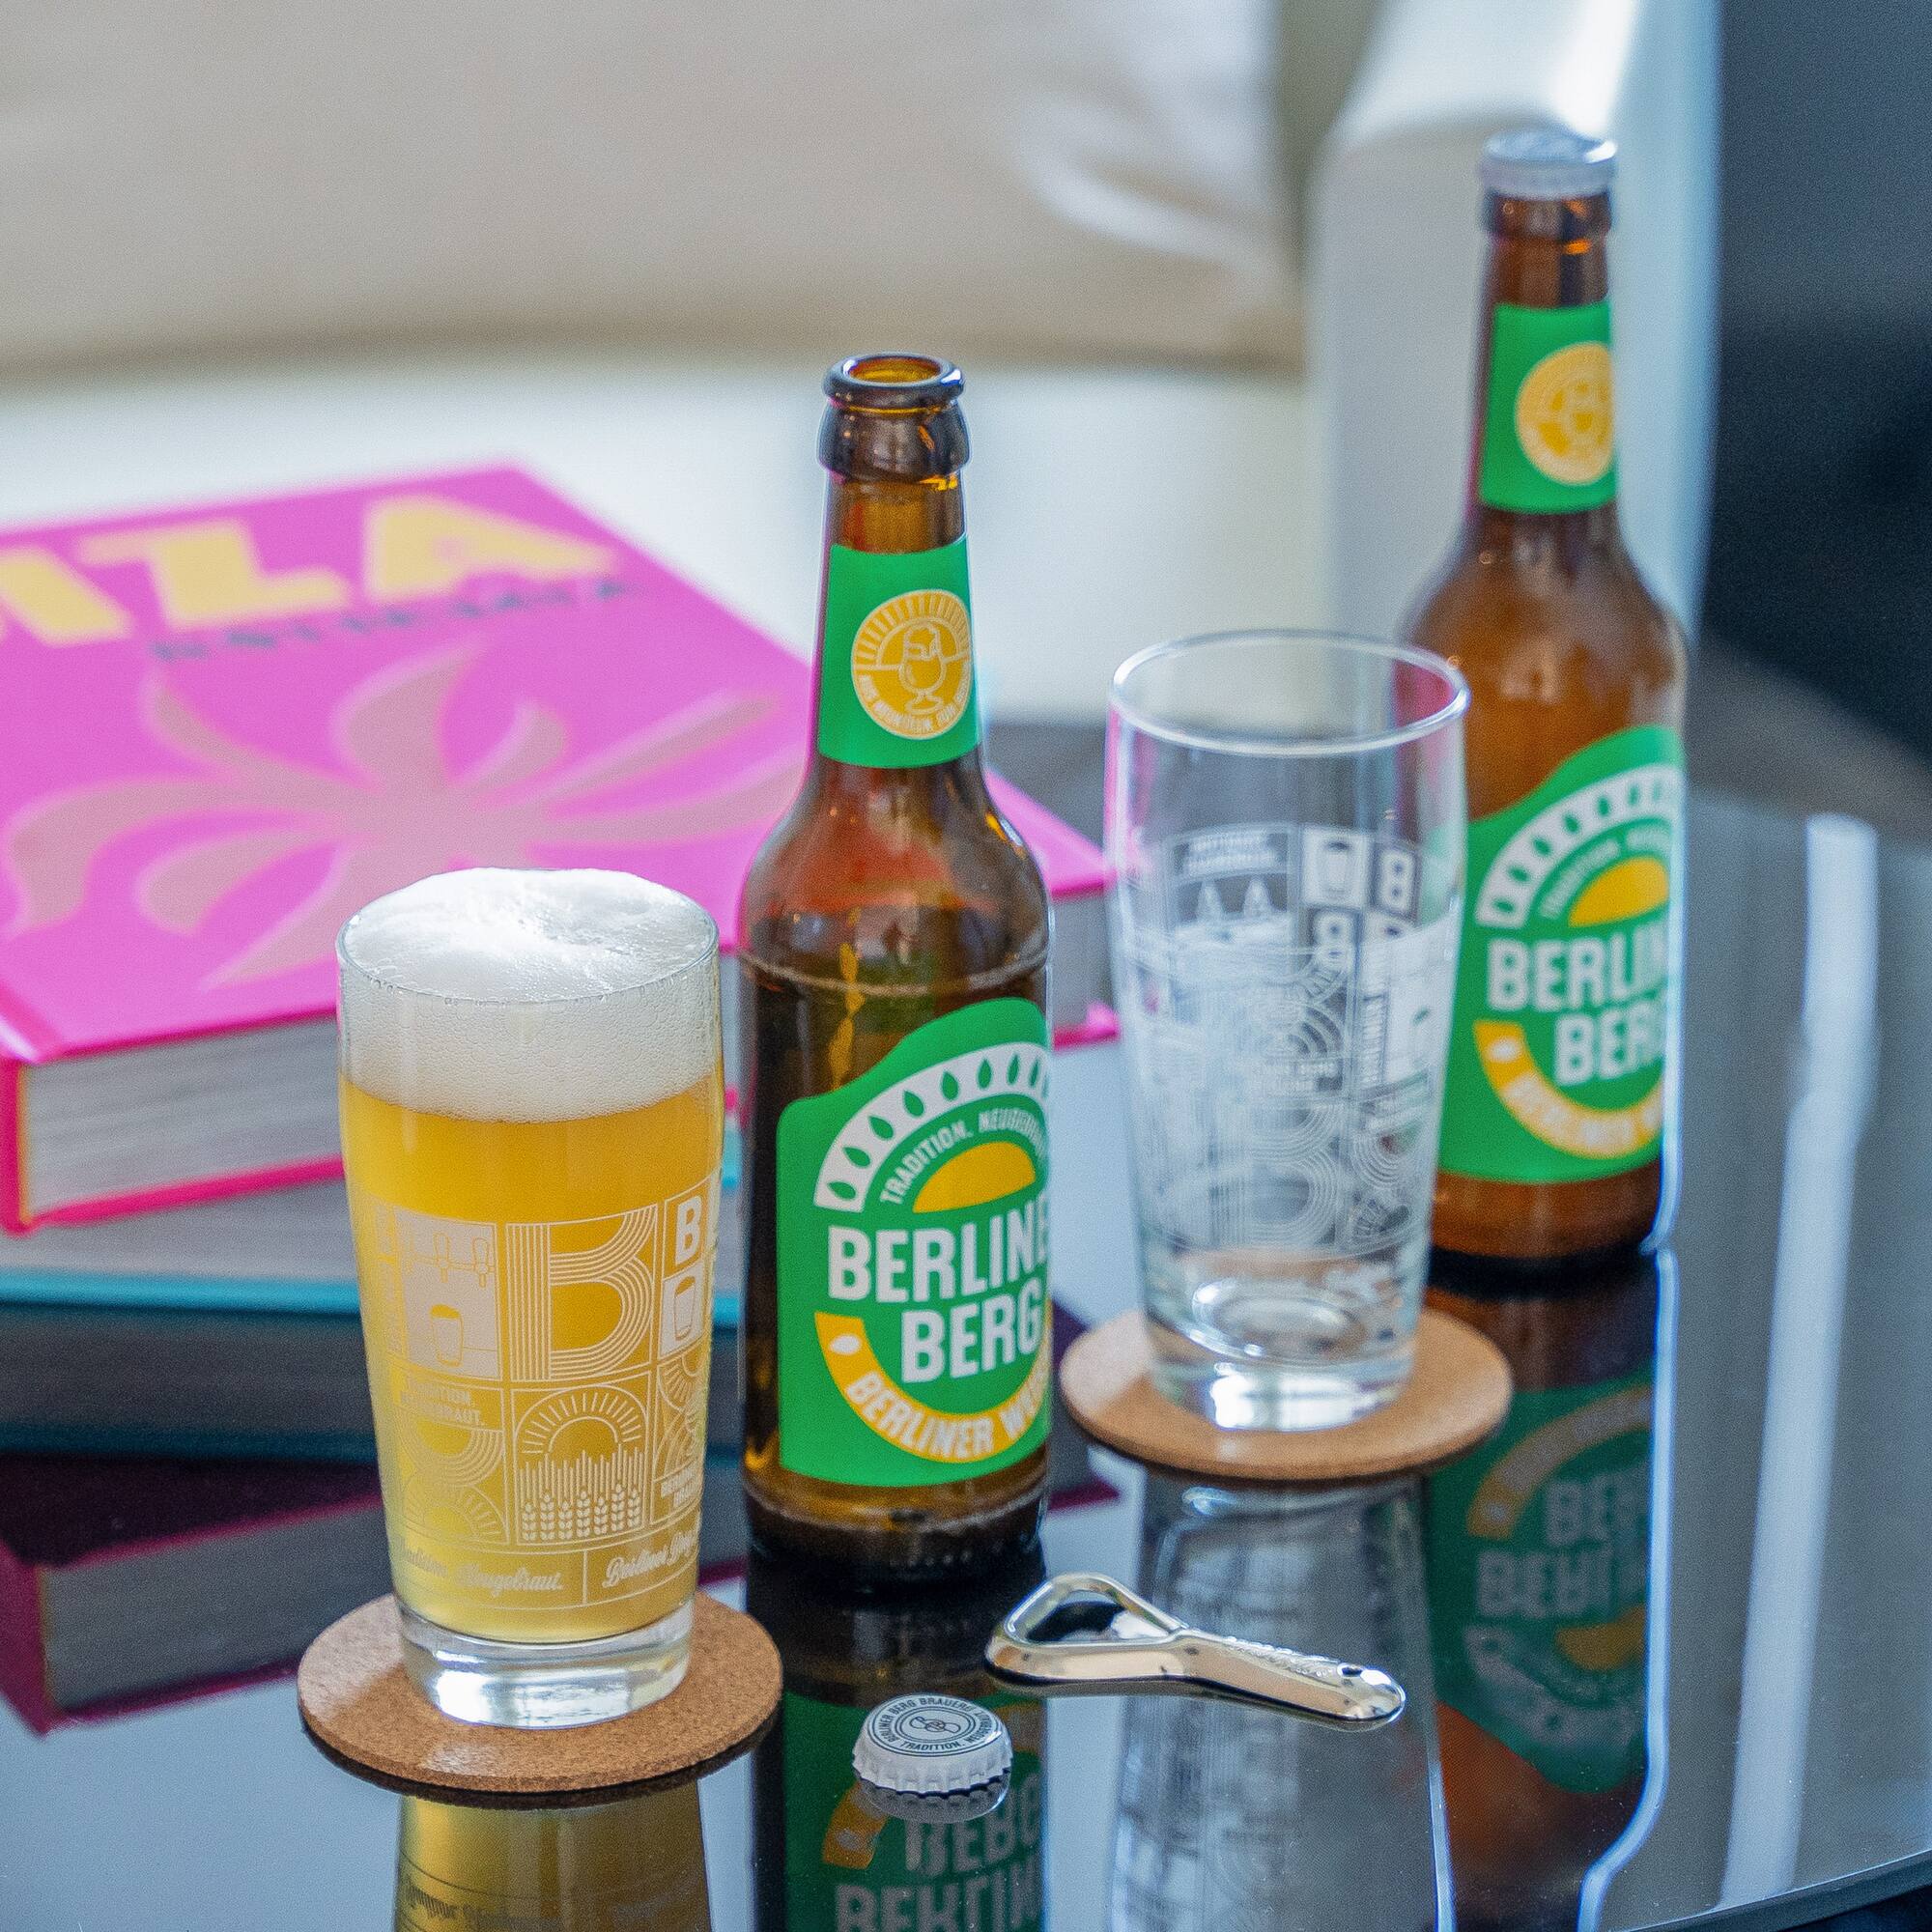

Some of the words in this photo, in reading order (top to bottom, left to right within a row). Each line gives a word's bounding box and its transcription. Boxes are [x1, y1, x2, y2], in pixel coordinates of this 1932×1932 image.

[880, 1120, 974, 1204] TRADITION.
[675, 1196, 703, 1266] B
[900, 1277, 1042, 1383] BERG
[845, 1371, 995, 1460] BERLINER
[889, 1699, 917, 1716] BERG
[899, 1740, 965, 1751] TRADITION.
